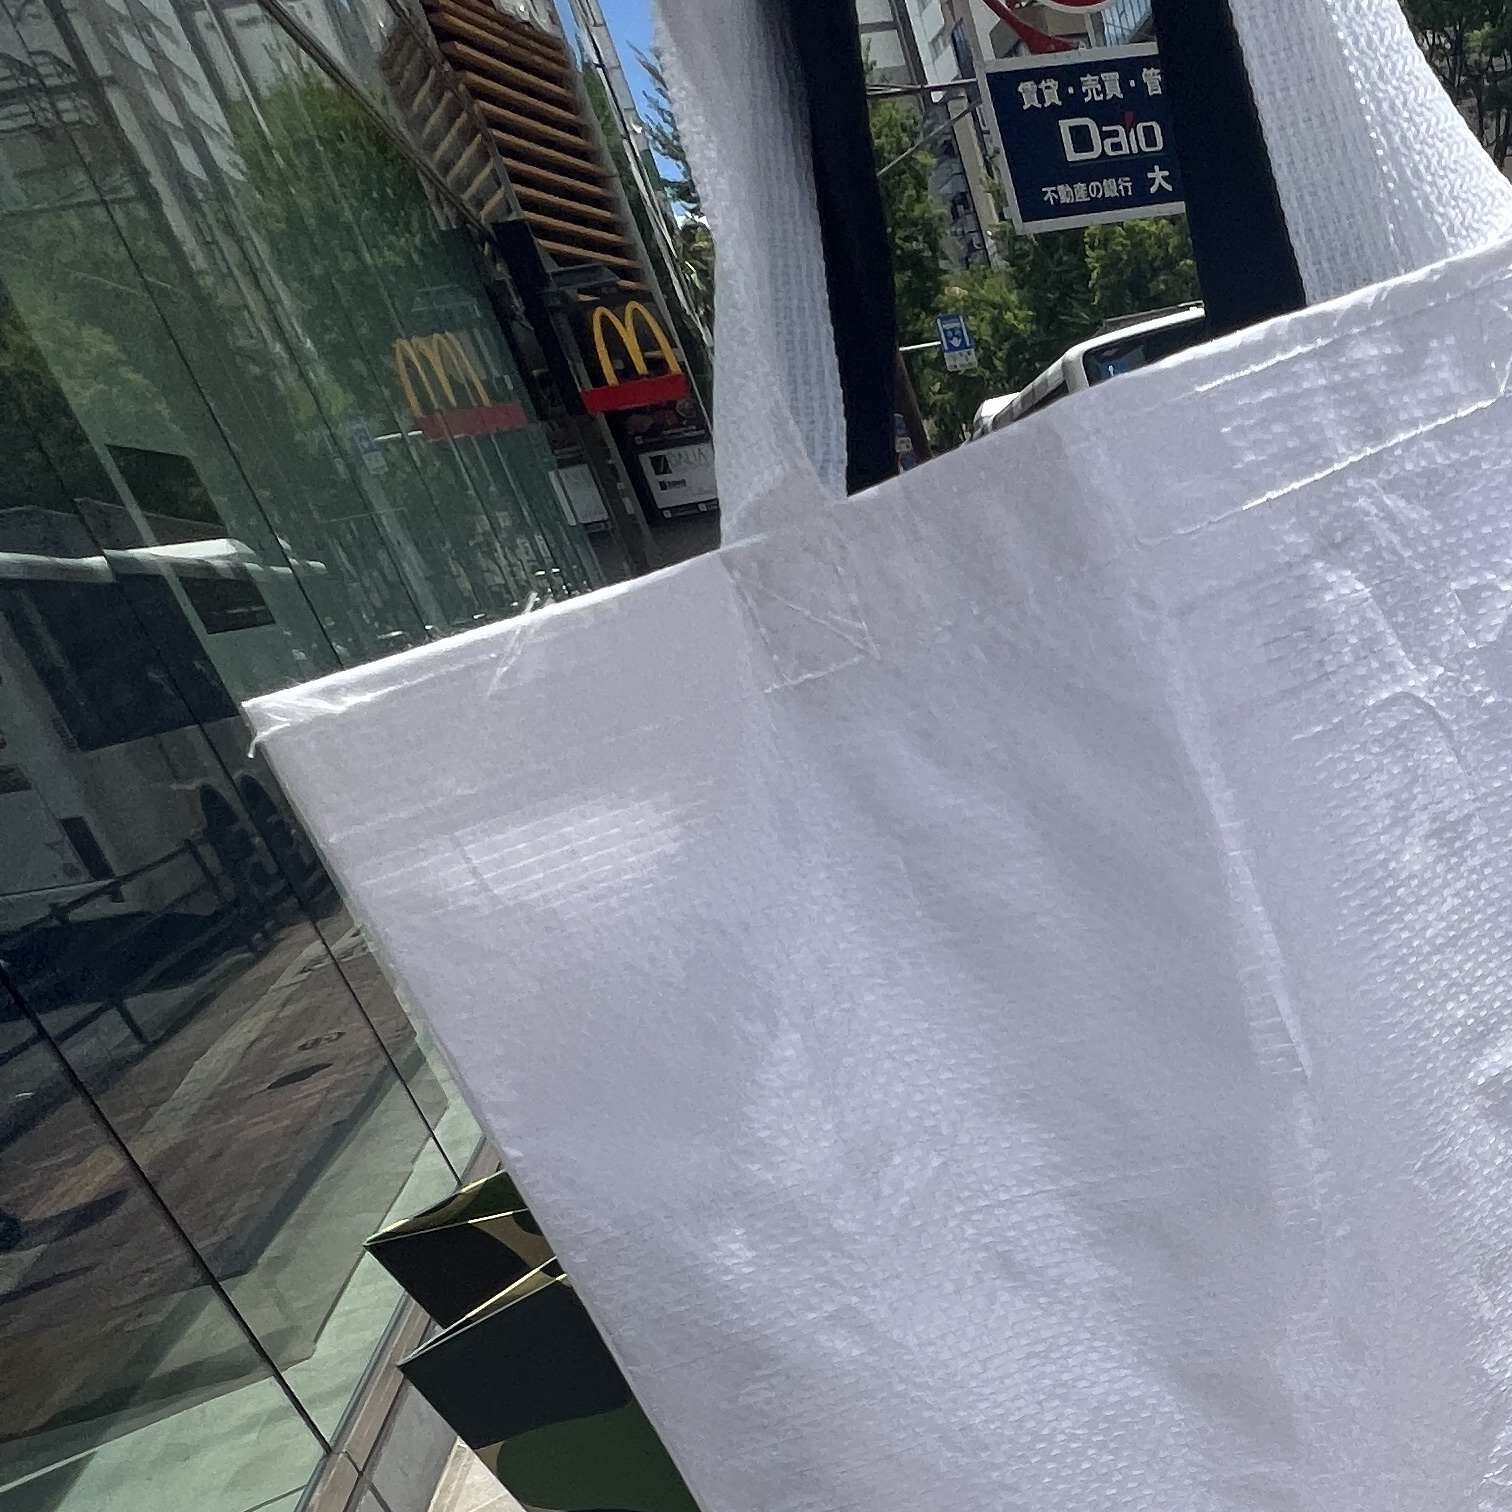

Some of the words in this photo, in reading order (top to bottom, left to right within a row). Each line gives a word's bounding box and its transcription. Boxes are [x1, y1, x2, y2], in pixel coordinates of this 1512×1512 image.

[1058, 112, 1164, 162] Daio
[1042, 177, 1133, 206] 不動産の銀行
[1147, 165, 1173, 194] 大
